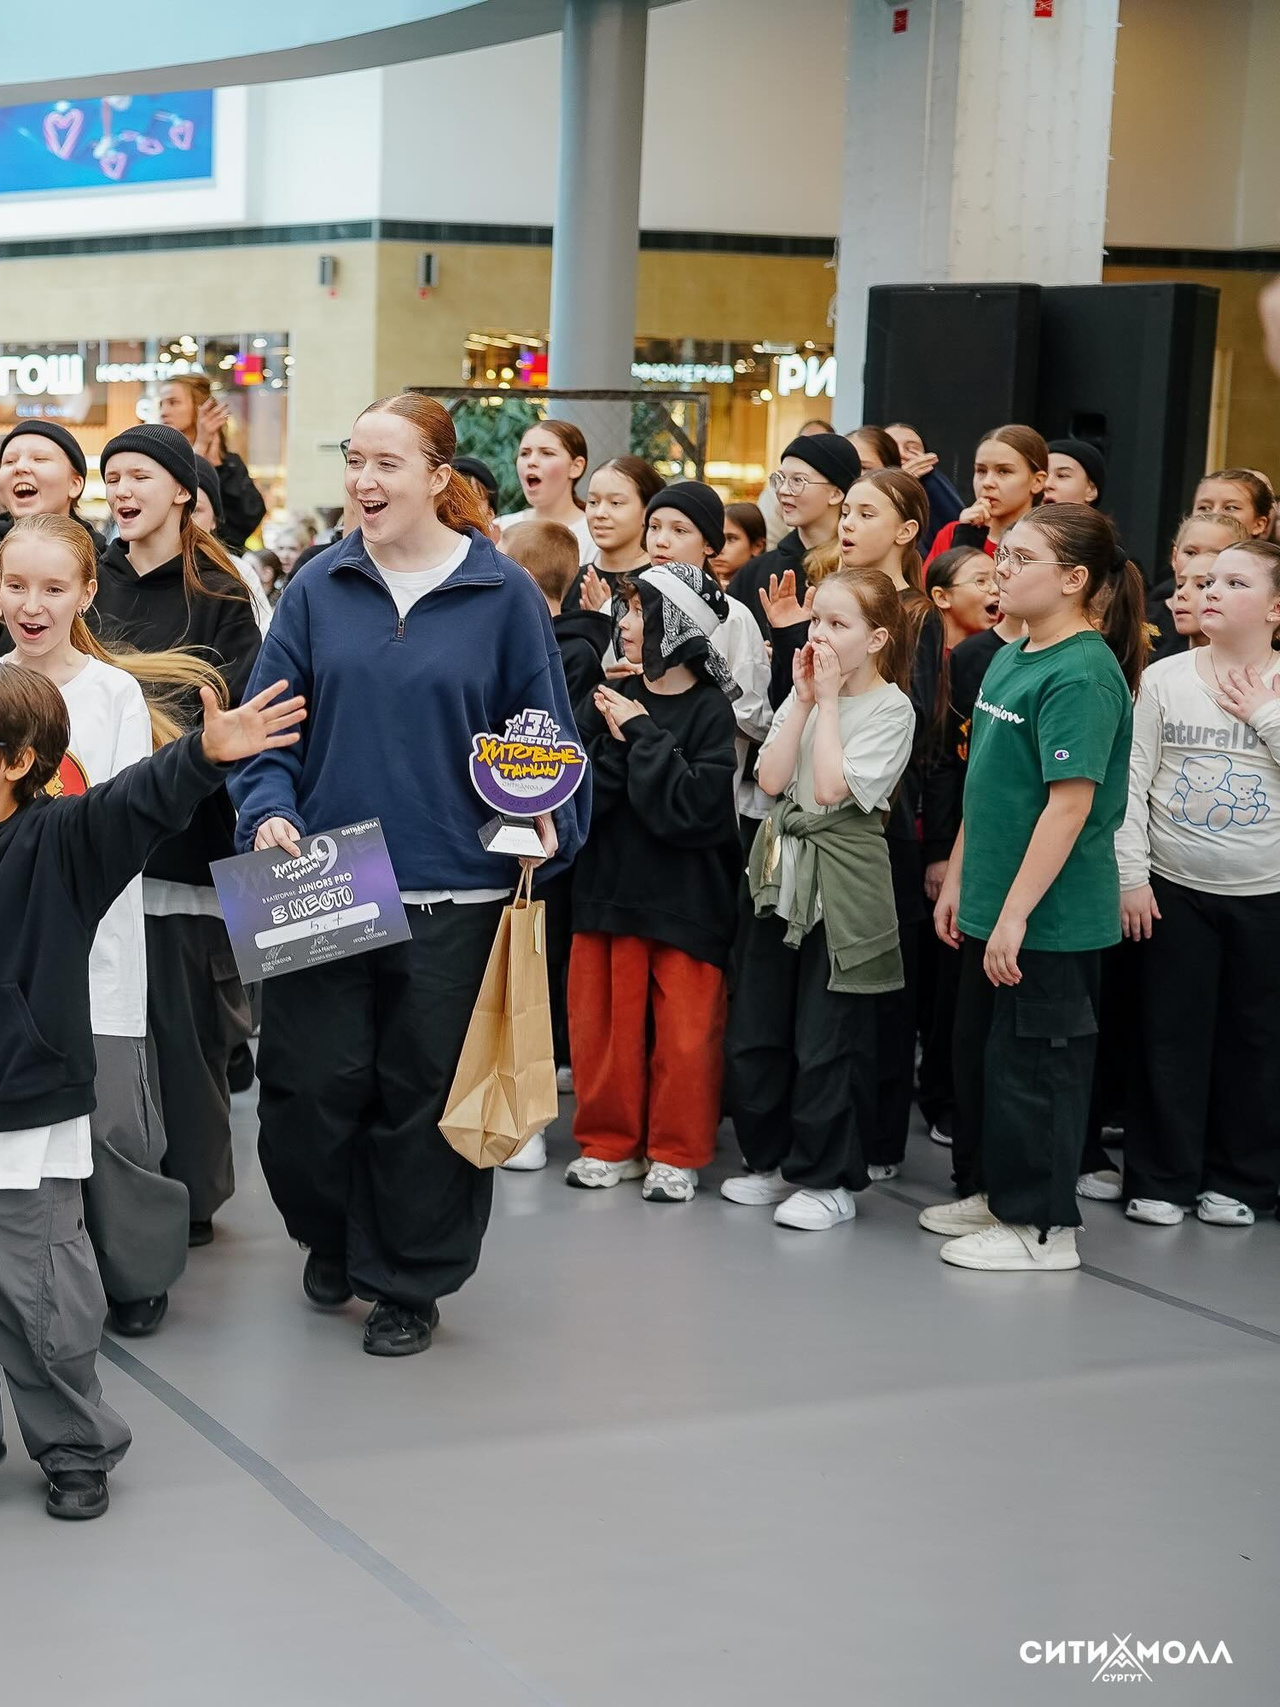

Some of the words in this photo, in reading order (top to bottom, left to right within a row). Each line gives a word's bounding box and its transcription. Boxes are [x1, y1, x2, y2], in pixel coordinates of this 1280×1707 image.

[777, 354, 837, 397] РИ
[524, 713, 544, 737] 3
[477, 738, 583, 767] ХИТОВЫЕ
[509, 734, 552, 746] МЕСТО
[498, 762, 560, 779] ТАНЦЫ
[310, 835, 339, 876] 9
[297, 877, 334, 895] JUNIORS
[334, 872, 353, 884] PRO
[288, 885, 354, 920] МЕСТО
